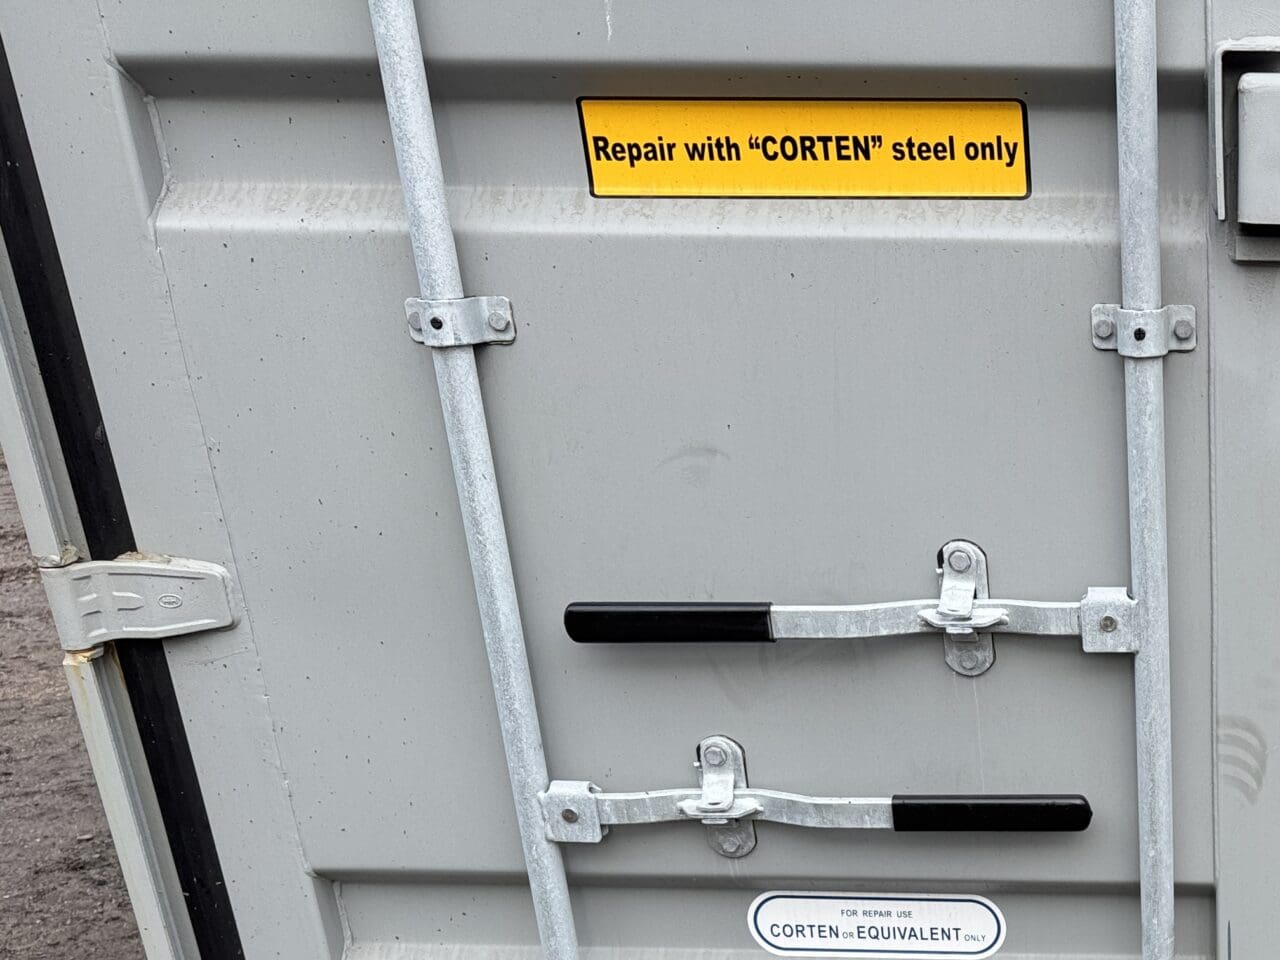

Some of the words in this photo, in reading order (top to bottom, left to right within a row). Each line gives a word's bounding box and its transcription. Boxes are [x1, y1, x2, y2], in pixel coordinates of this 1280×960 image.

[593, 135, 676, 167] Repair
[686, 136, 741, 161] with
[892, 136, 956, 161] steel
[964, 136, 1018, 167] only
[840, 909, 858, 917] FOR
[863, 910, 892, 918] REPAIR
[770, 923, 840, 939] CORTEN
[842, 931, 855, 939] OR
[857, 926, 962, 942] EQUIVALENT
[964, 934, 986, 942] ONLY
